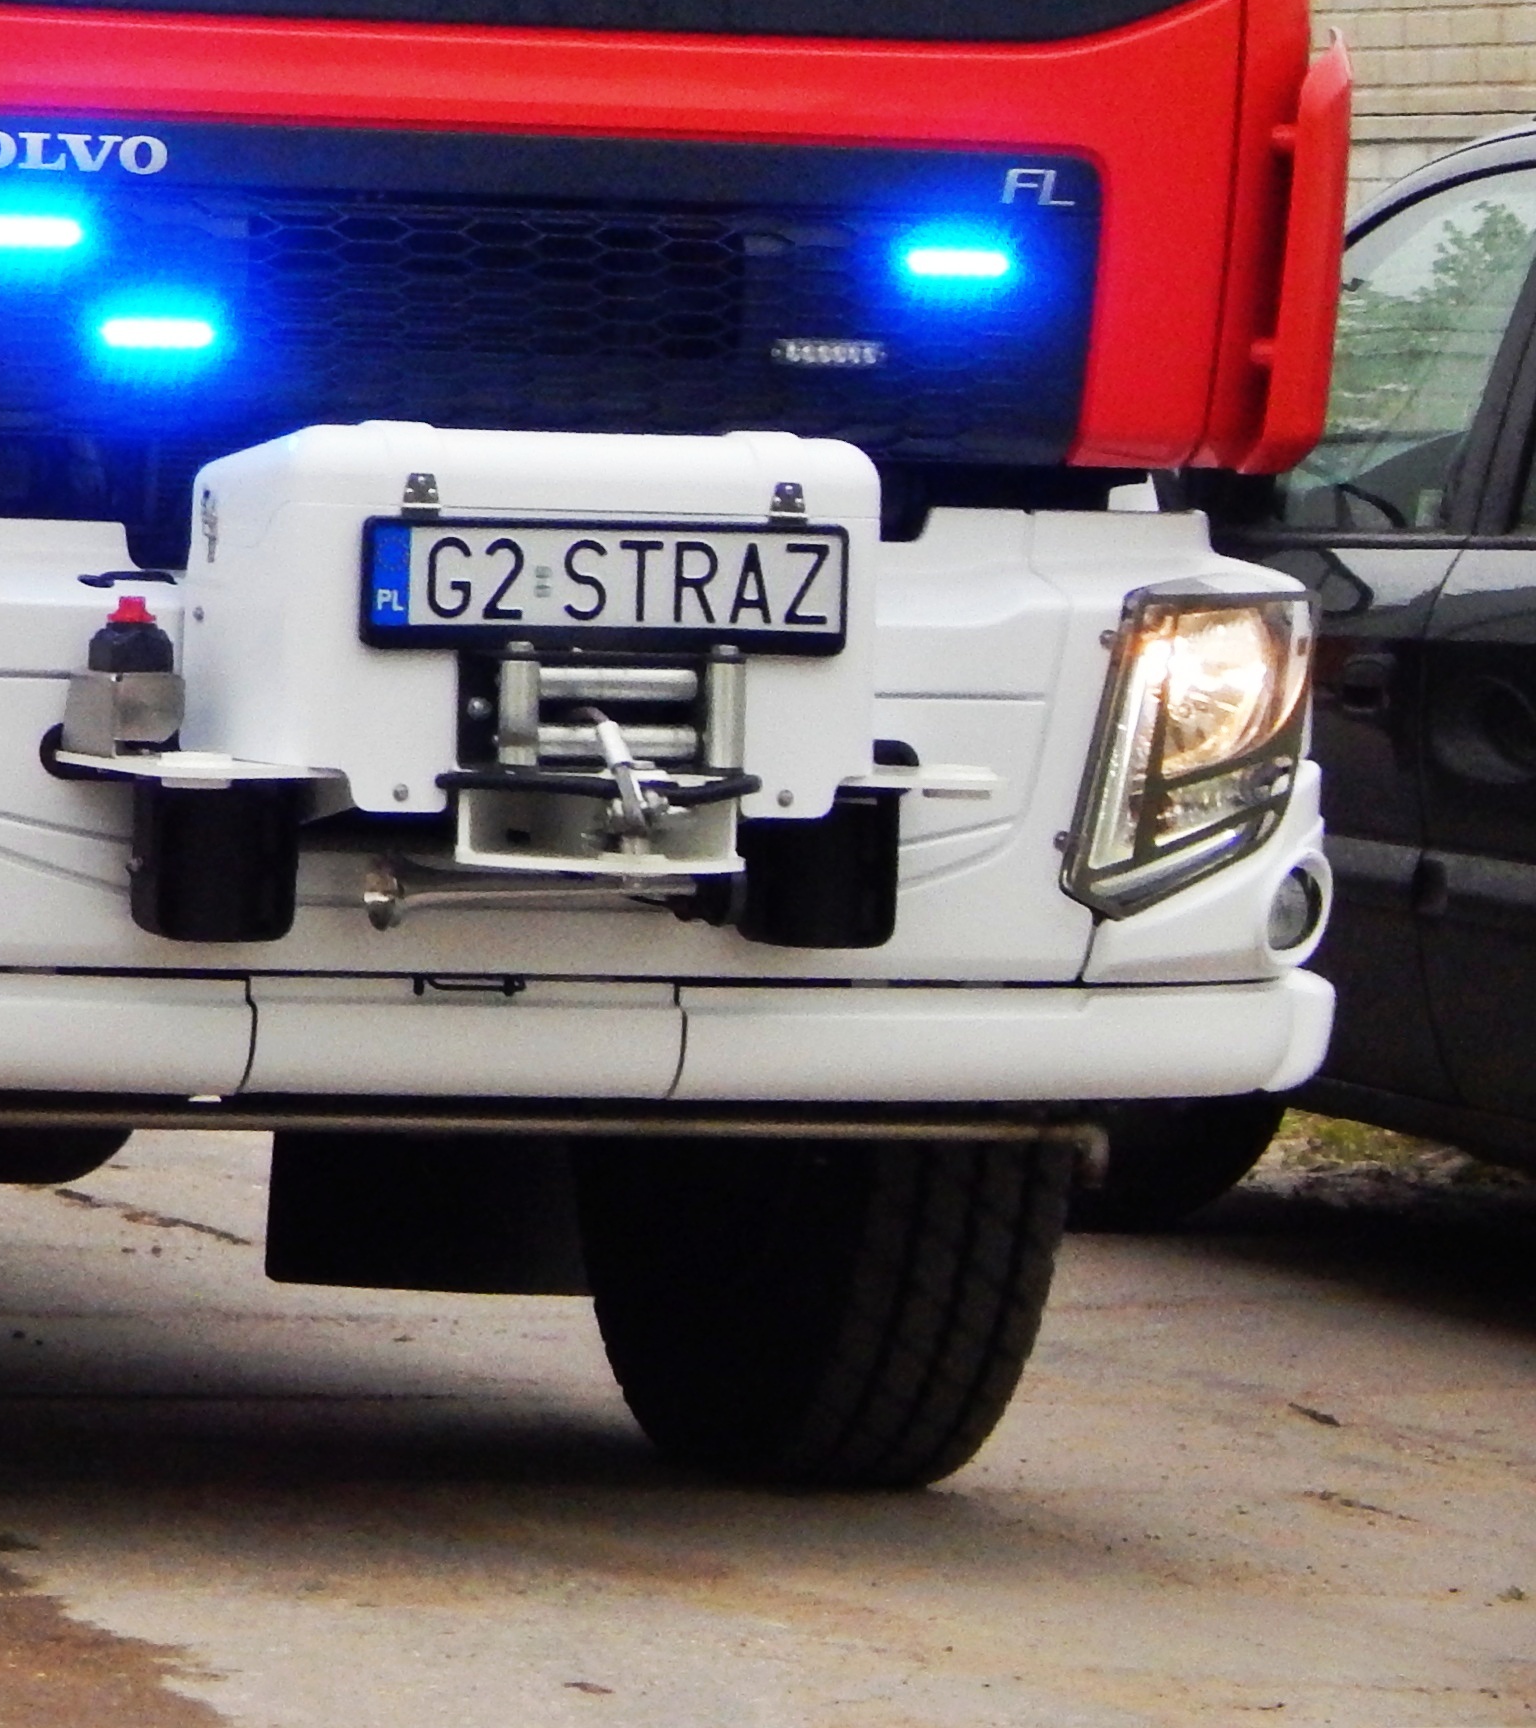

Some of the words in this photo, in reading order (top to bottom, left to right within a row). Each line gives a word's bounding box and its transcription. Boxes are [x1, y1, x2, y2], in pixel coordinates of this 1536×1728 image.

[999, 168, 1075, 206] FL
[377, 590, 403, 612] PL
[428, 537, 525, 620] G2
[564, 539, 829, 625] STRAZ
